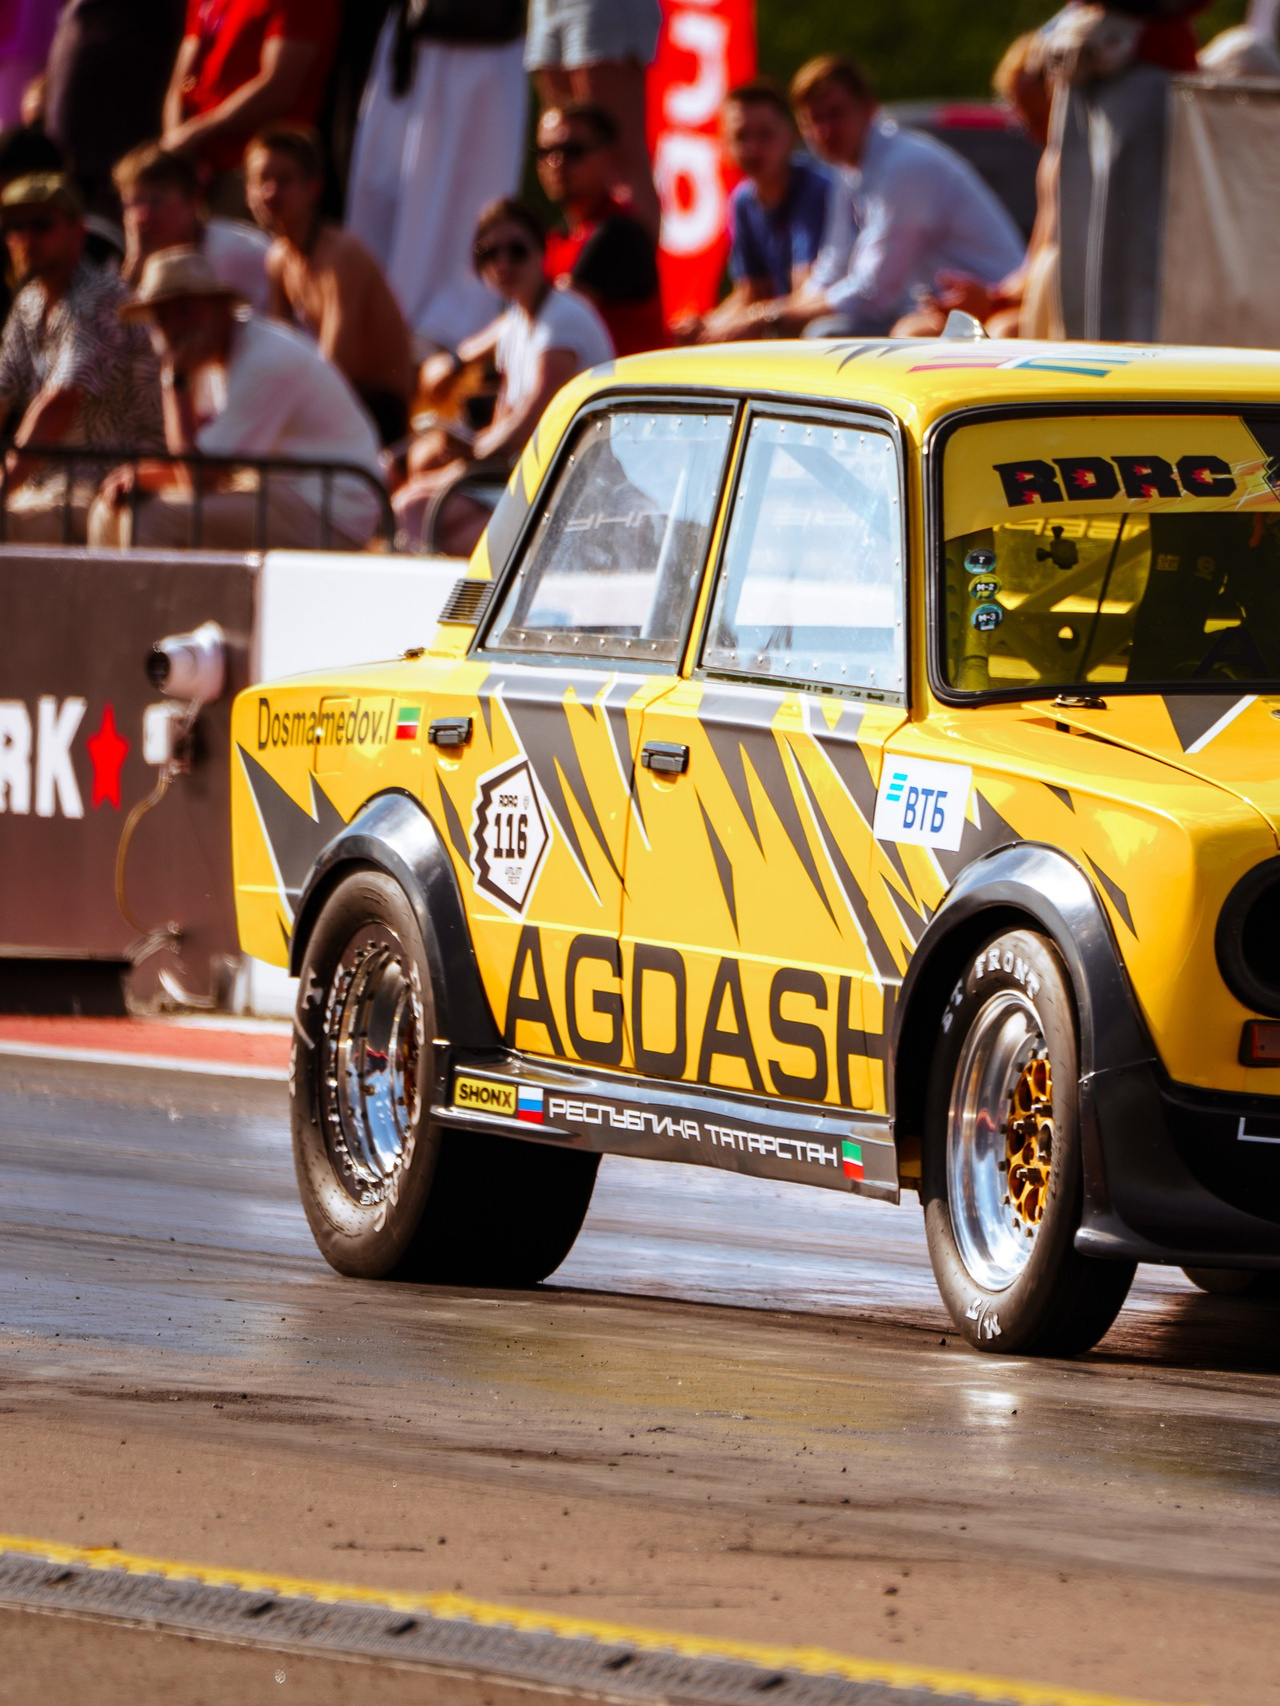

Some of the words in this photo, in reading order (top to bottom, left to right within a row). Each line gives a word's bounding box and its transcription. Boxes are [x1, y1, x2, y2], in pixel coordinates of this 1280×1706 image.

[992, 455, 1237, 508] RDRC
[903, 786, 948, 834] ВТБ
[493, 813, 529, 860] 116
[504, 924, 897, 1116] AGDASH
[459, 1082, 513, 1109] SHONX
[704, 1124, 838, 1168] ТАТАРСТАН
